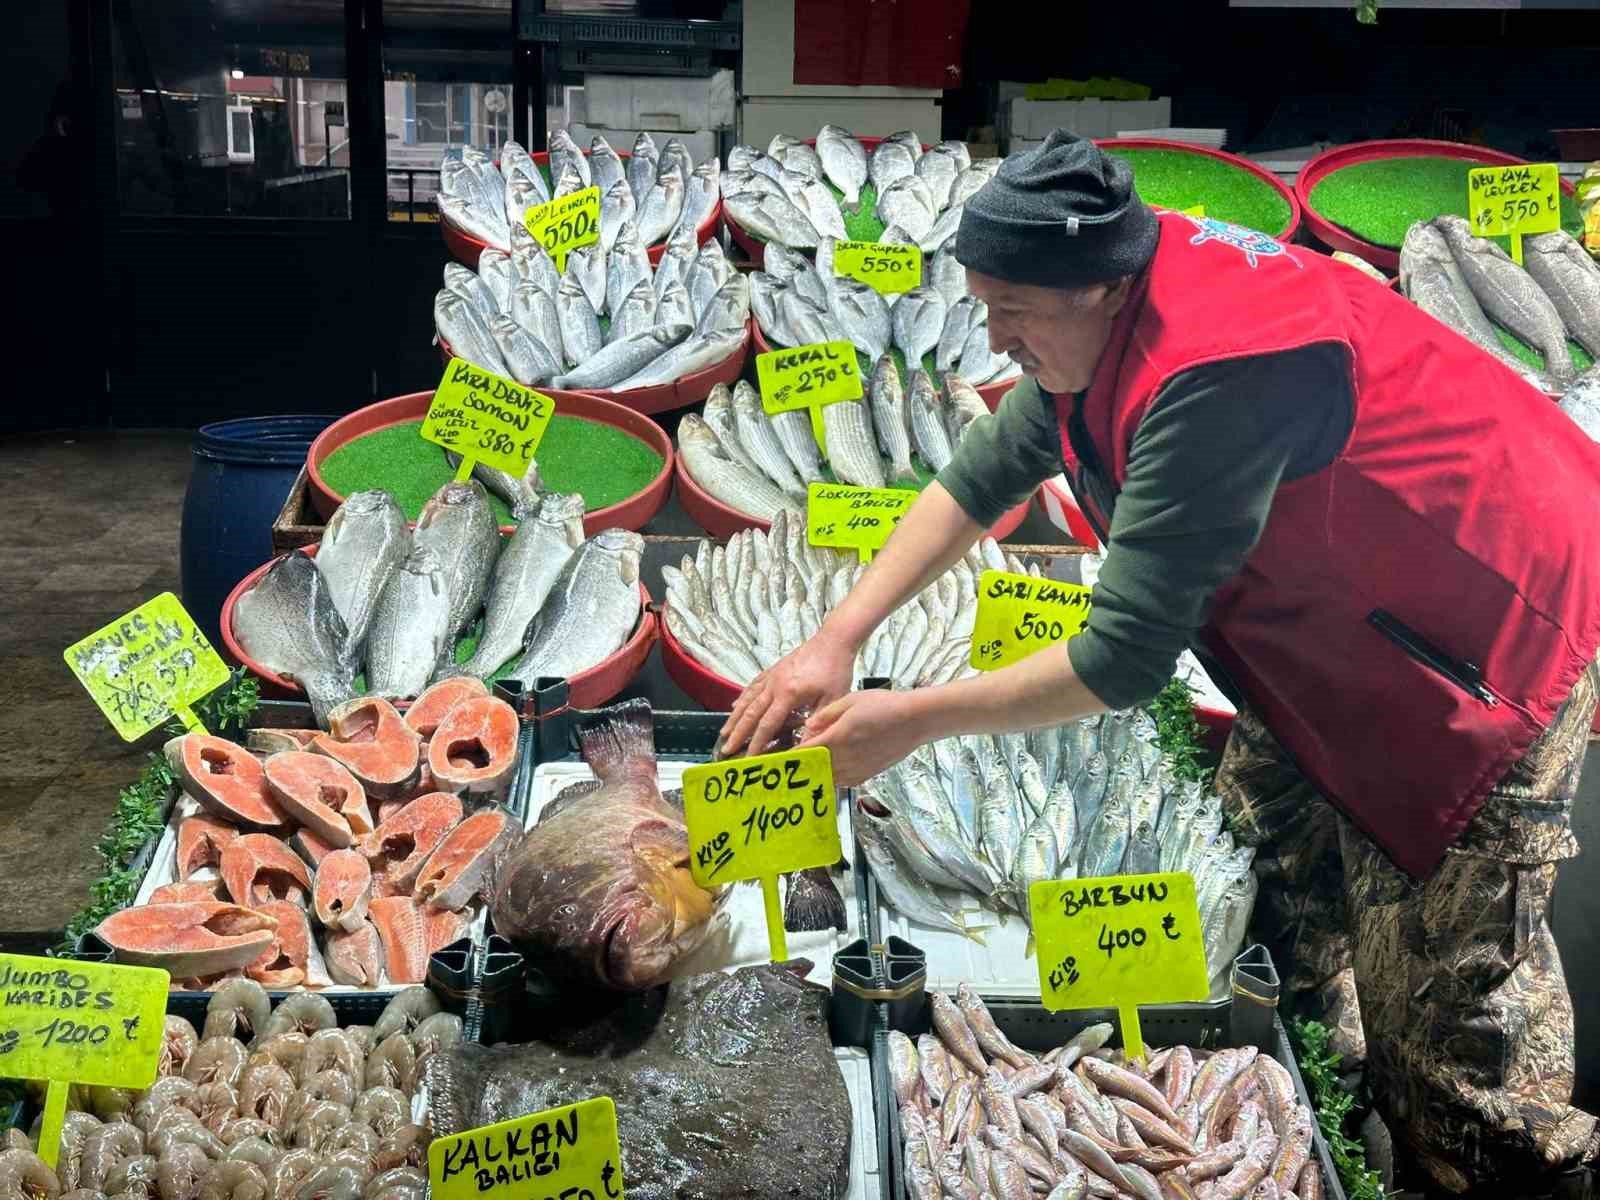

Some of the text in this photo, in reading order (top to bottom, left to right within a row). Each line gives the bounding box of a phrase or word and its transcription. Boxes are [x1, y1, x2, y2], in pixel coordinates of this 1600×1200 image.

[1500, 199, 1540, 221] 550
[544, 210, 589, 250] 550
[860, 256, 902, 273] 550
[796, 365, 837, 393] 250
[478, 428, 515, 455] 380
[846, 514, 880, 530] 400
[1014, 611, 1064, 641] 500
[741, 803, 804, 846] 1400
[1060, 881, 1168, 917] BARBUN
[1098, 923, 1147, 959] 400
[34, 1017, 111, 1048] 1200
[442, 1108, 578, 1183] KALKAN
